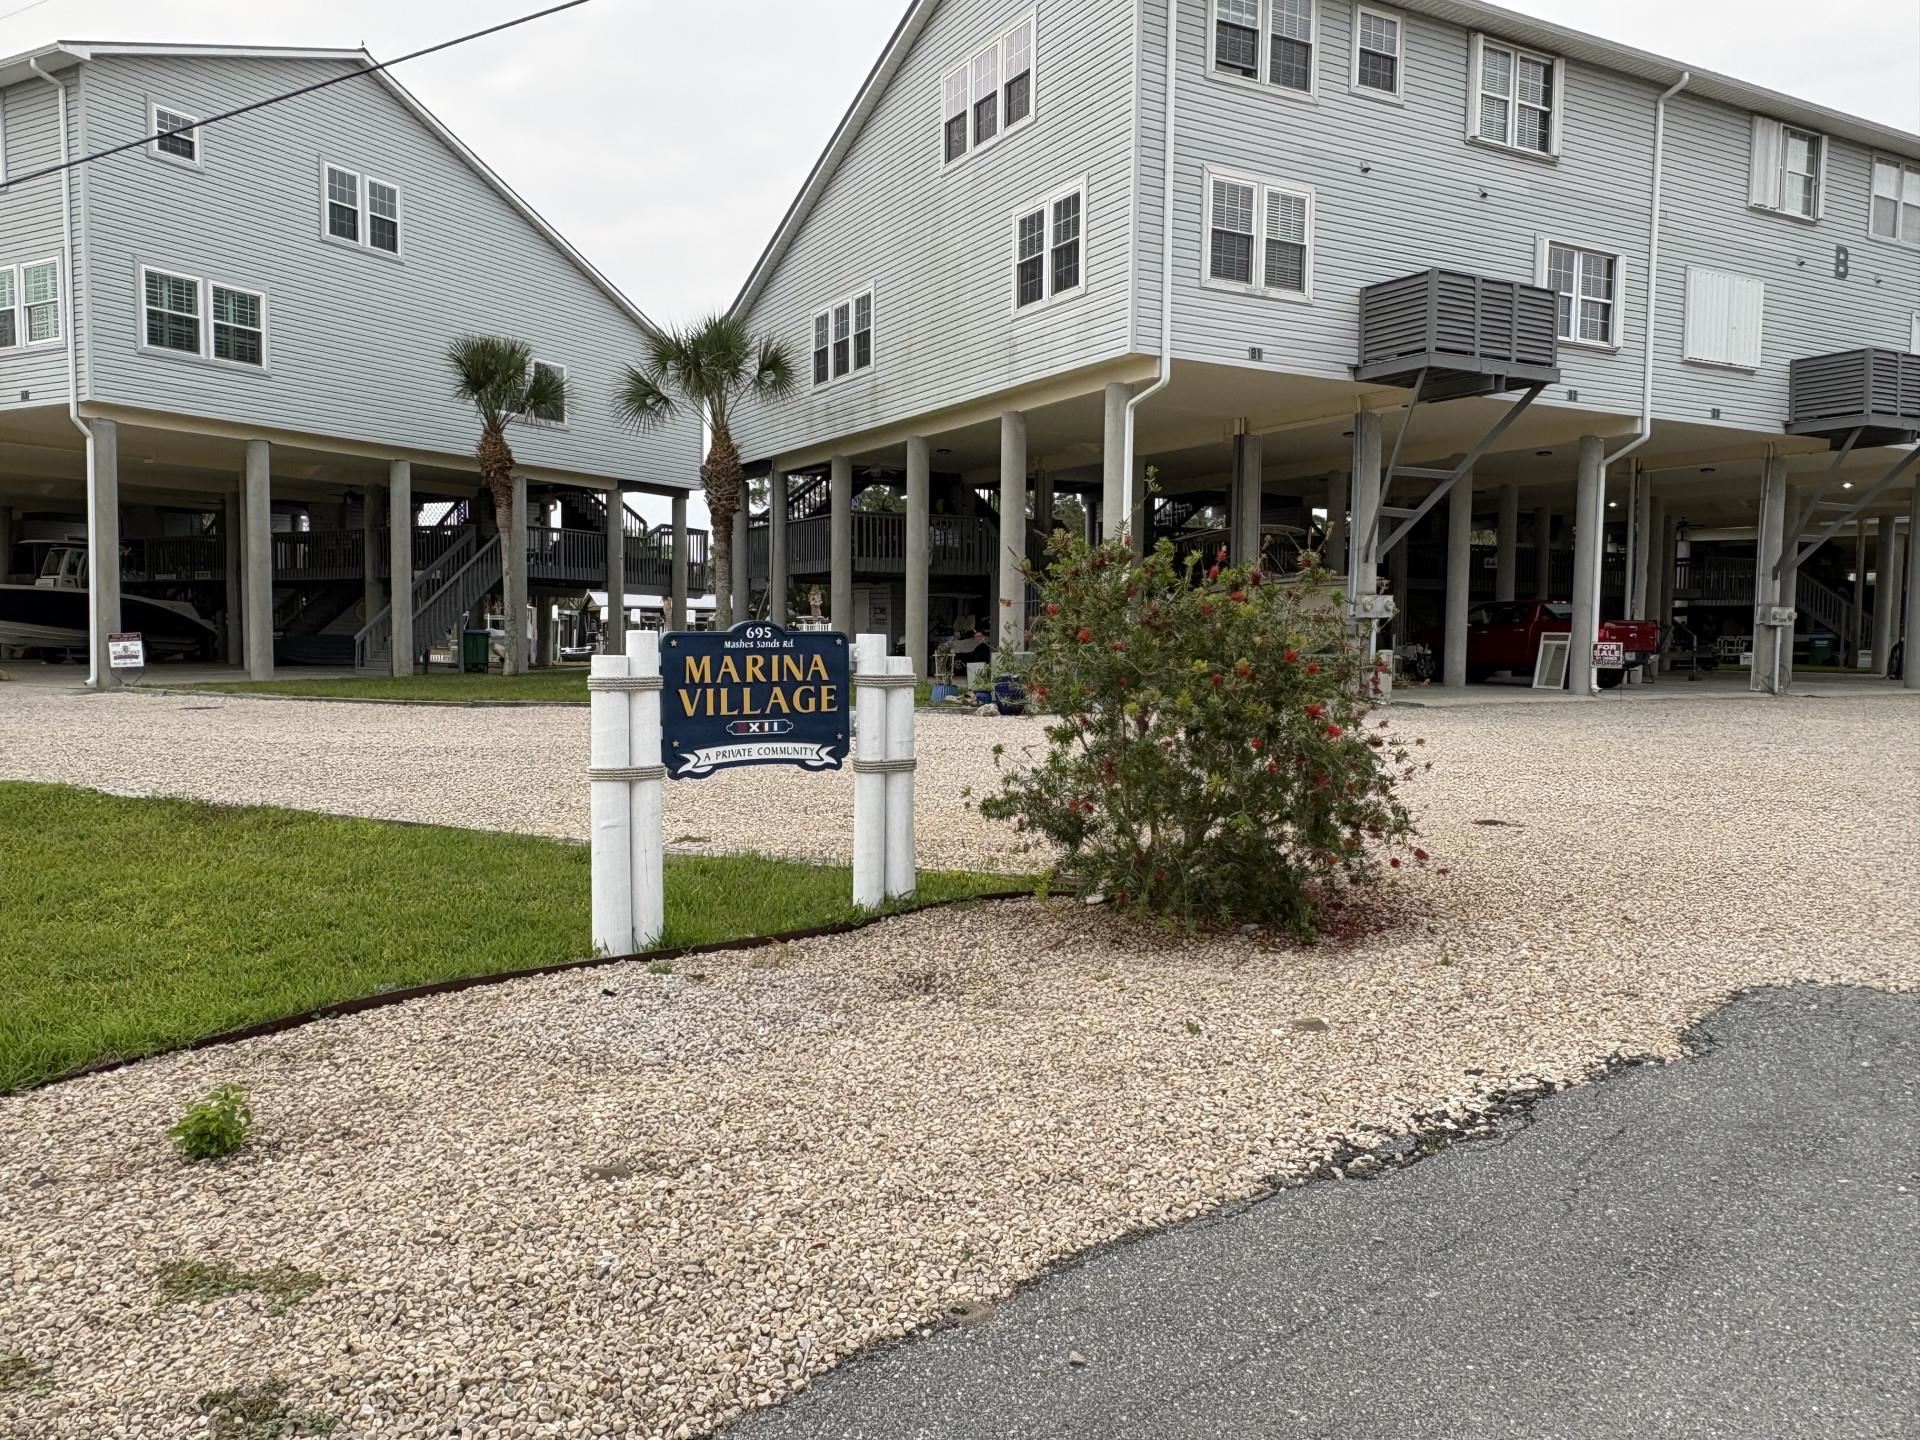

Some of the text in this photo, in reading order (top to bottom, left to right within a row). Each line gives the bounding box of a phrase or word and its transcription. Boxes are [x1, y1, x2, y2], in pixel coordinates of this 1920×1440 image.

[1834, 245, 1848, 280] B
[724, 639, 753, 649] Mashes
[756, 639, 780, 649] Sands
[746, 627, 771, 639] 695
[685, 654, 829, 684] MARINA
[678, 685, 838, 717] VILLAGE
[703, 746, 816, 762] A PRIVATE COMMUNITY
